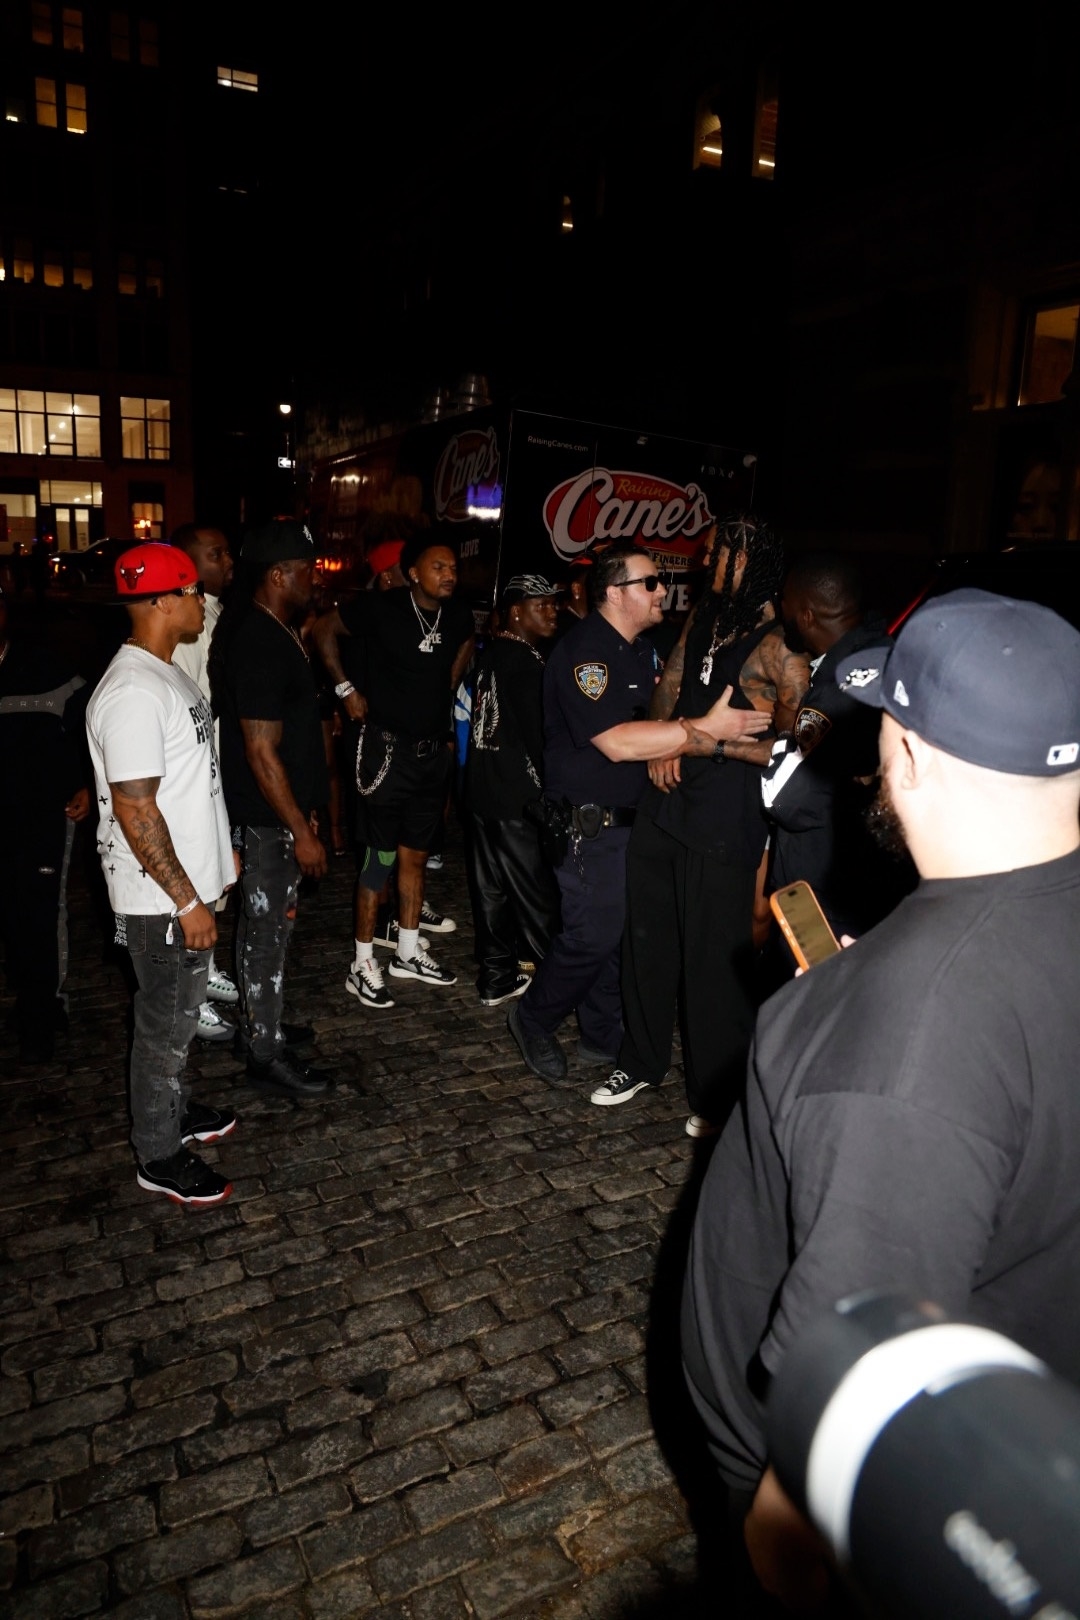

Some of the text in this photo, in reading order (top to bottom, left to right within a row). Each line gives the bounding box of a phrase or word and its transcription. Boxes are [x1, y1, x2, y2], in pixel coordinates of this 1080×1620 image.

[527, 435, 588, 452] RaisingCanes.com
[616, 478, 672, 502] Raising
[552, 469, 712, 553] Cane's
[459, 538, 480, 559] LOVE
[653, 552, 694, 566] FINGERS
[661, 584, 690, 611] VE
